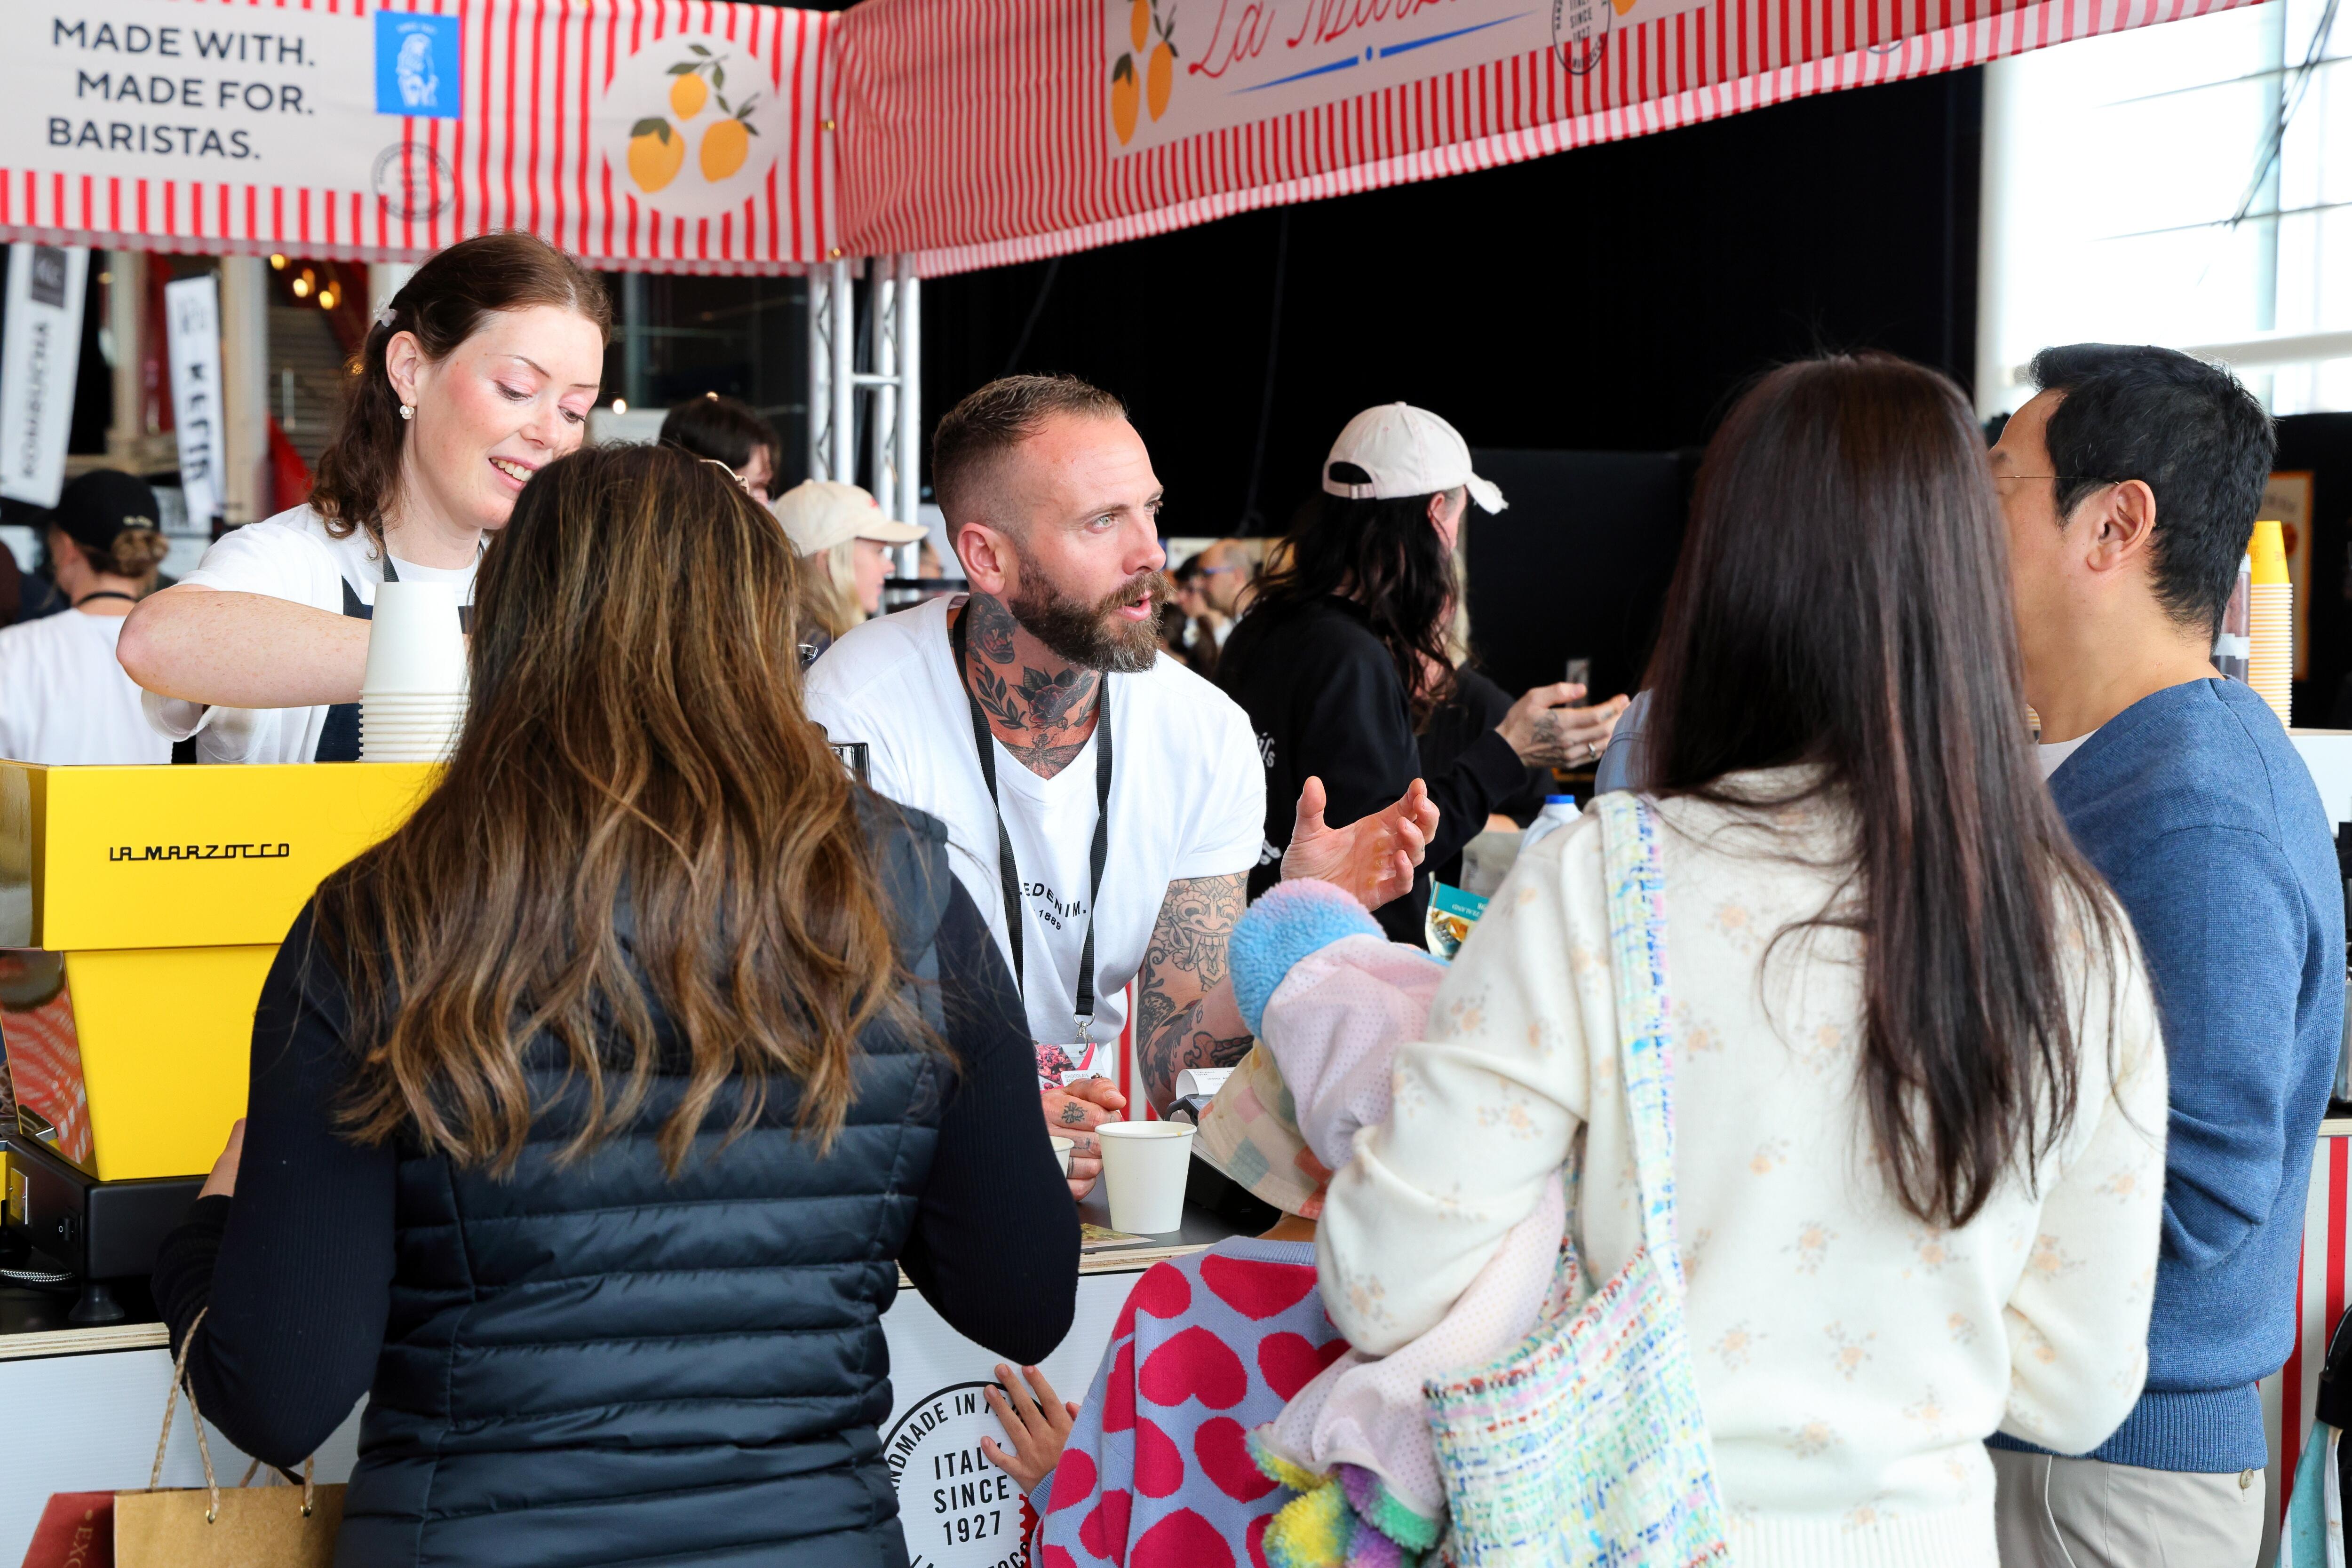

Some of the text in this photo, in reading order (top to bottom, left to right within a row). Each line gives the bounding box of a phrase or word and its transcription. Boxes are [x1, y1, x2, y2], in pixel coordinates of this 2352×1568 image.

[53, 18, 316, 67] MADE WITH.
[76, 70, 314, 115] MADE FOR.
[48, 118, 260, 159] BARISTAS.
[110, 844, 289, 861] LA MARZOCCO
[1020, 883, 1086, 917] EDENIM.
[1039, 910, 1061, 930] 1889
[888, 1402, 948, 1497] NDMADE
[955, 1394, 975, 1416] IN
[934, 1475, 1010, 1514] SINCE
[943, 1511, 1001, 1546] 1927
